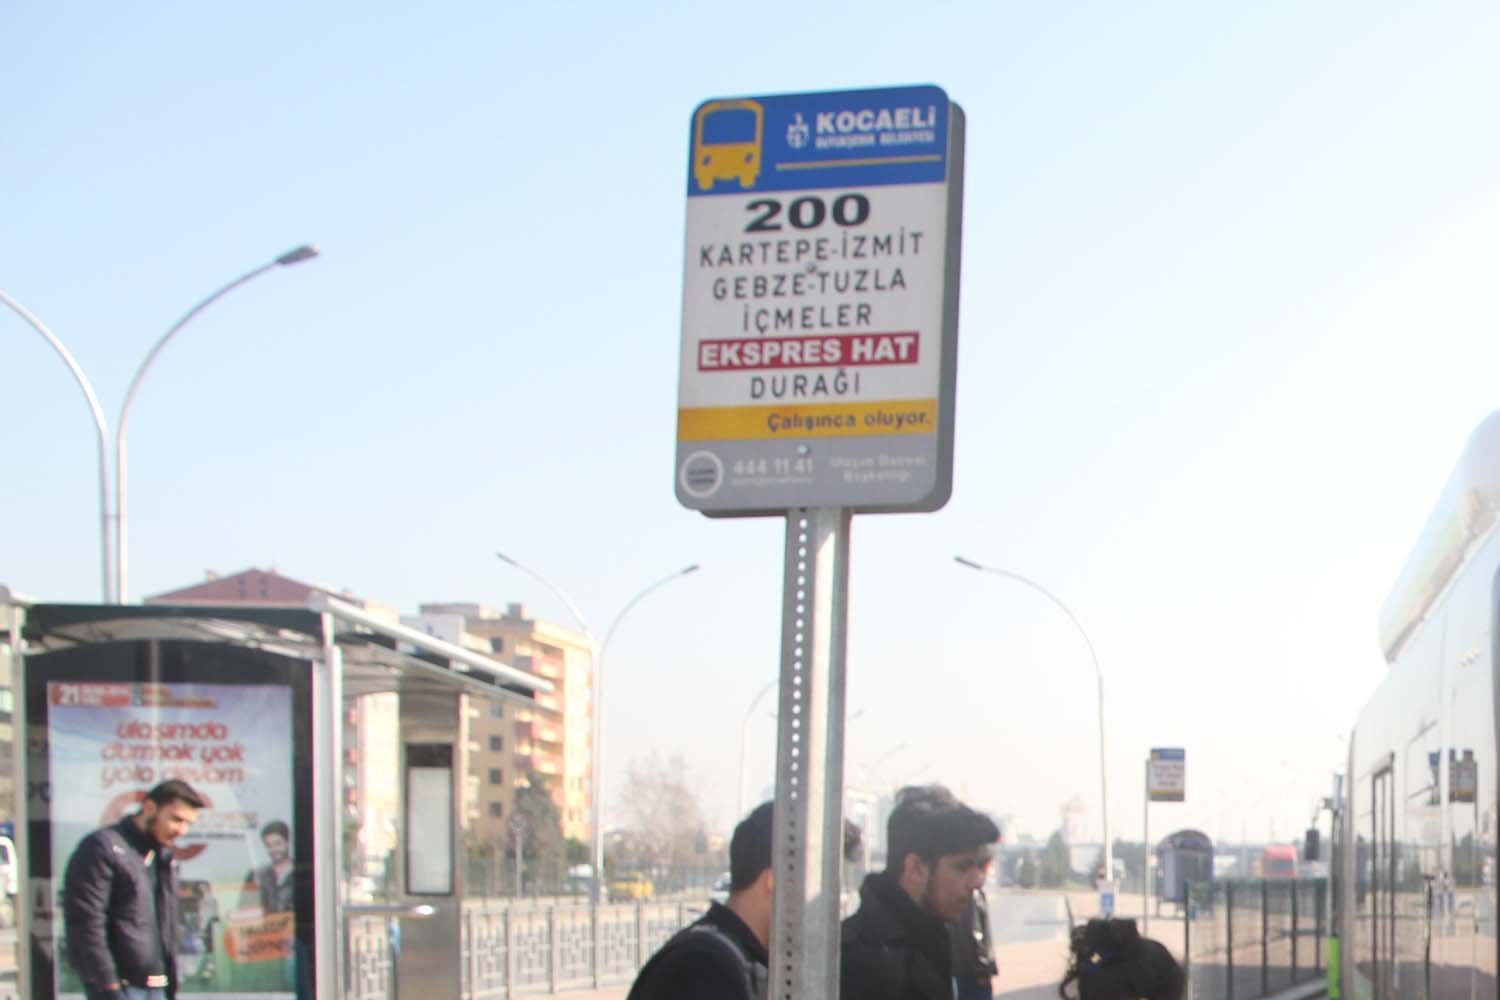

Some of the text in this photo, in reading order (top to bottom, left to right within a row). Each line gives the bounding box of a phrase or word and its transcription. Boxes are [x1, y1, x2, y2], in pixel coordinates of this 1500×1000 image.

[744, 193, 870, 233] 200
[700, 227, 924, 268] KARTEPE-İZMİT
[713, 267, 907, 301] GEBZE-TUZLA
[743, 303, 872, 334] İÇMELER
[701, 336, 915, 368] EKSPRES HAT
[750, 369, 860, 399] DURAĞI
